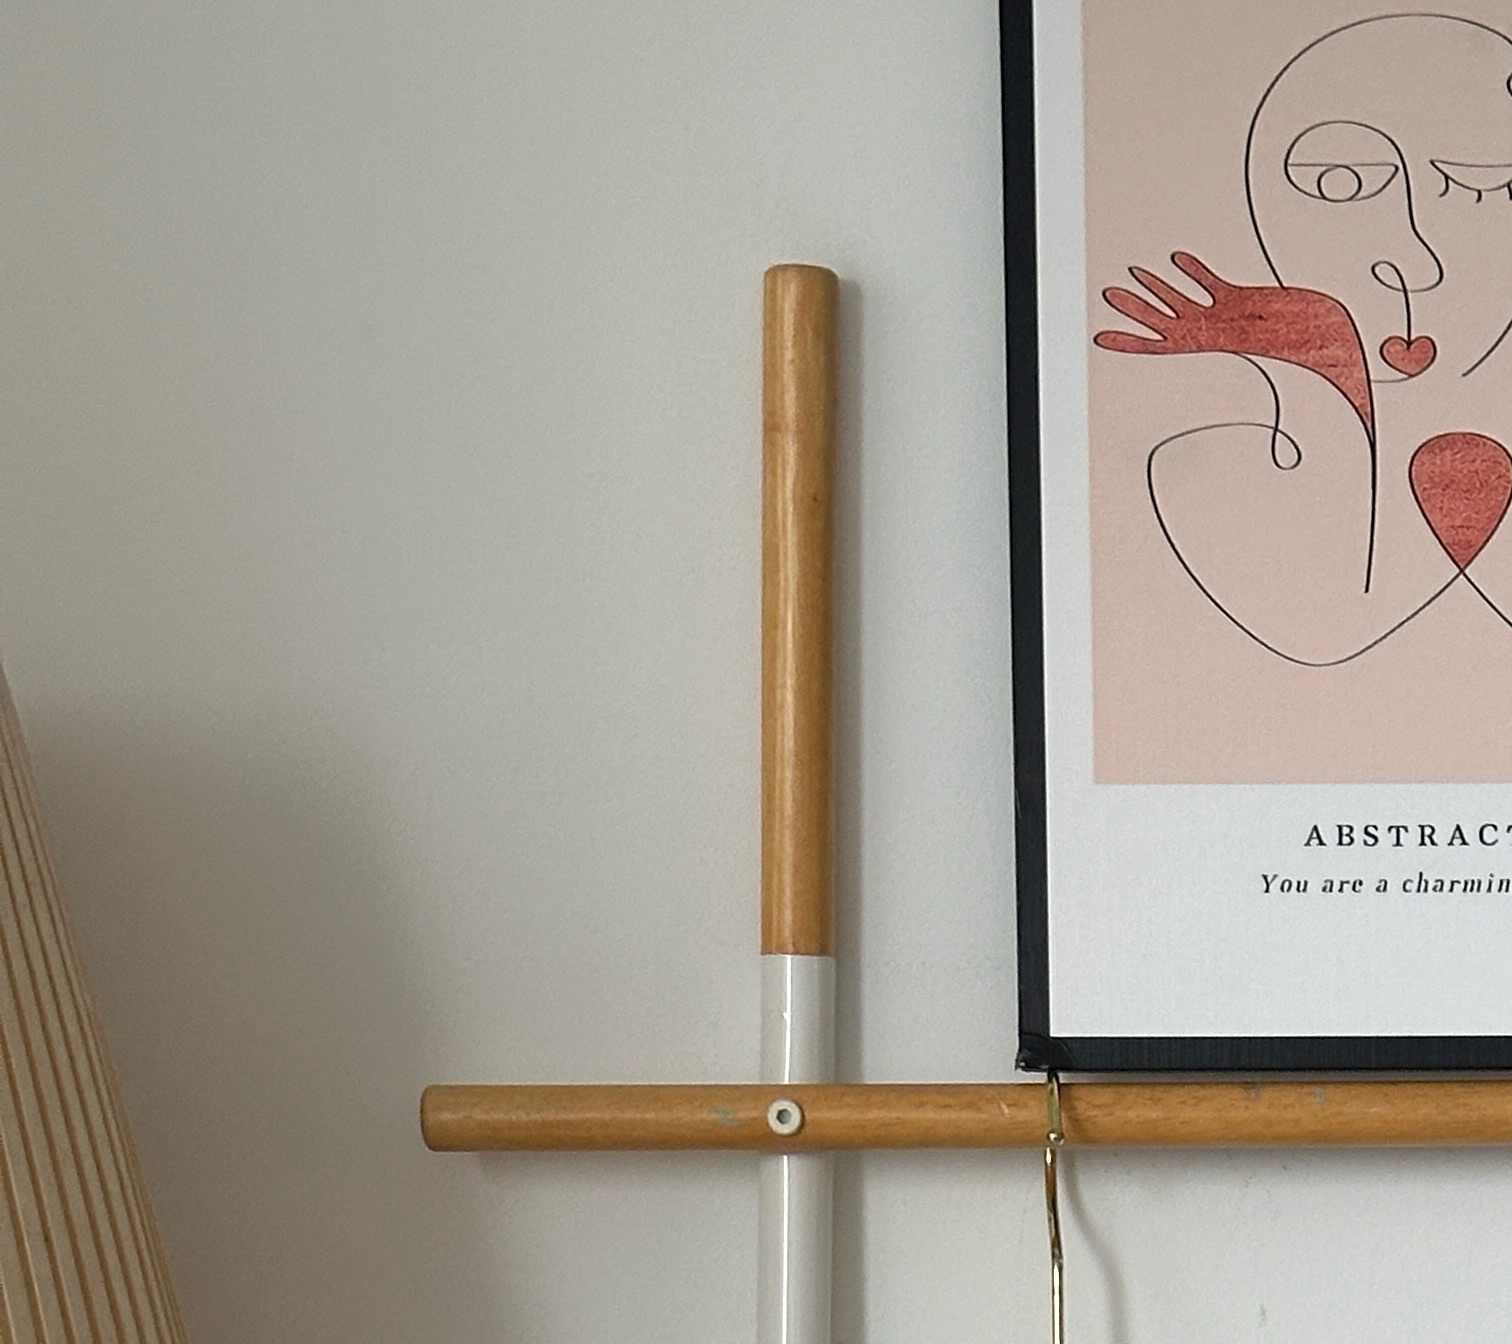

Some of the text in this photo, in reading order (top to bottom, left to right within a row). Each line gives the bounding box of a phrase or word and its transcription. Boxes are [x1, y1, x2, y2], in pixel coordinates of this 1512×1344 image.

[1261, 873, 1309, 894] You
[1321, 877, 1364, 894] are
[1375, 877, 1389, 894] a
